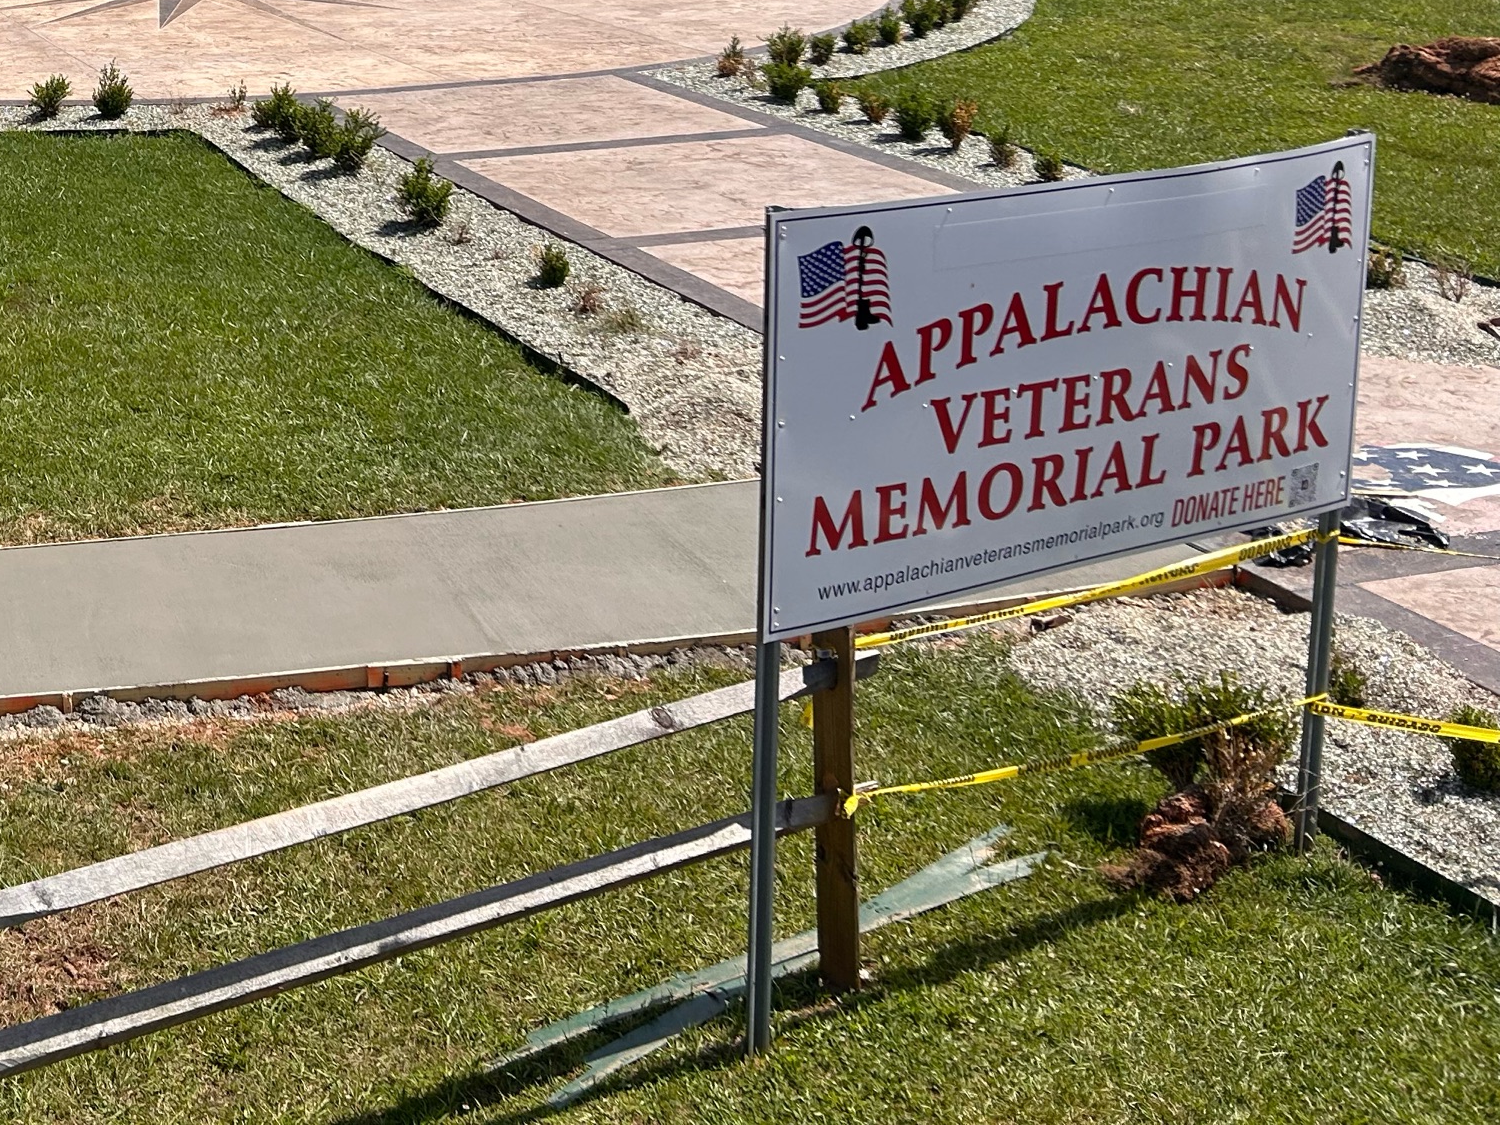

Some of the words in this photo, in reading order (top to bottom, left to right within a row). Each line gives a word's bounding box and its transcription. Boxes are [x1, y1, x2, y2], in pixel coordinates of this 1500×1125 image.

[861, 265, 1306, 412] APPALACHIAN
[930, 344, 1251, 454] VETERANS
[805, 433, 1167, 558] MEMORIAL
[1187, 395, 1329, 478] PARK
[1171, 486, 1240, 528] DONATE
[1242, 476, 1286, 512] HERE
[817, 511, 1164, 601] www.appalachianveteransmemorialpark.org
